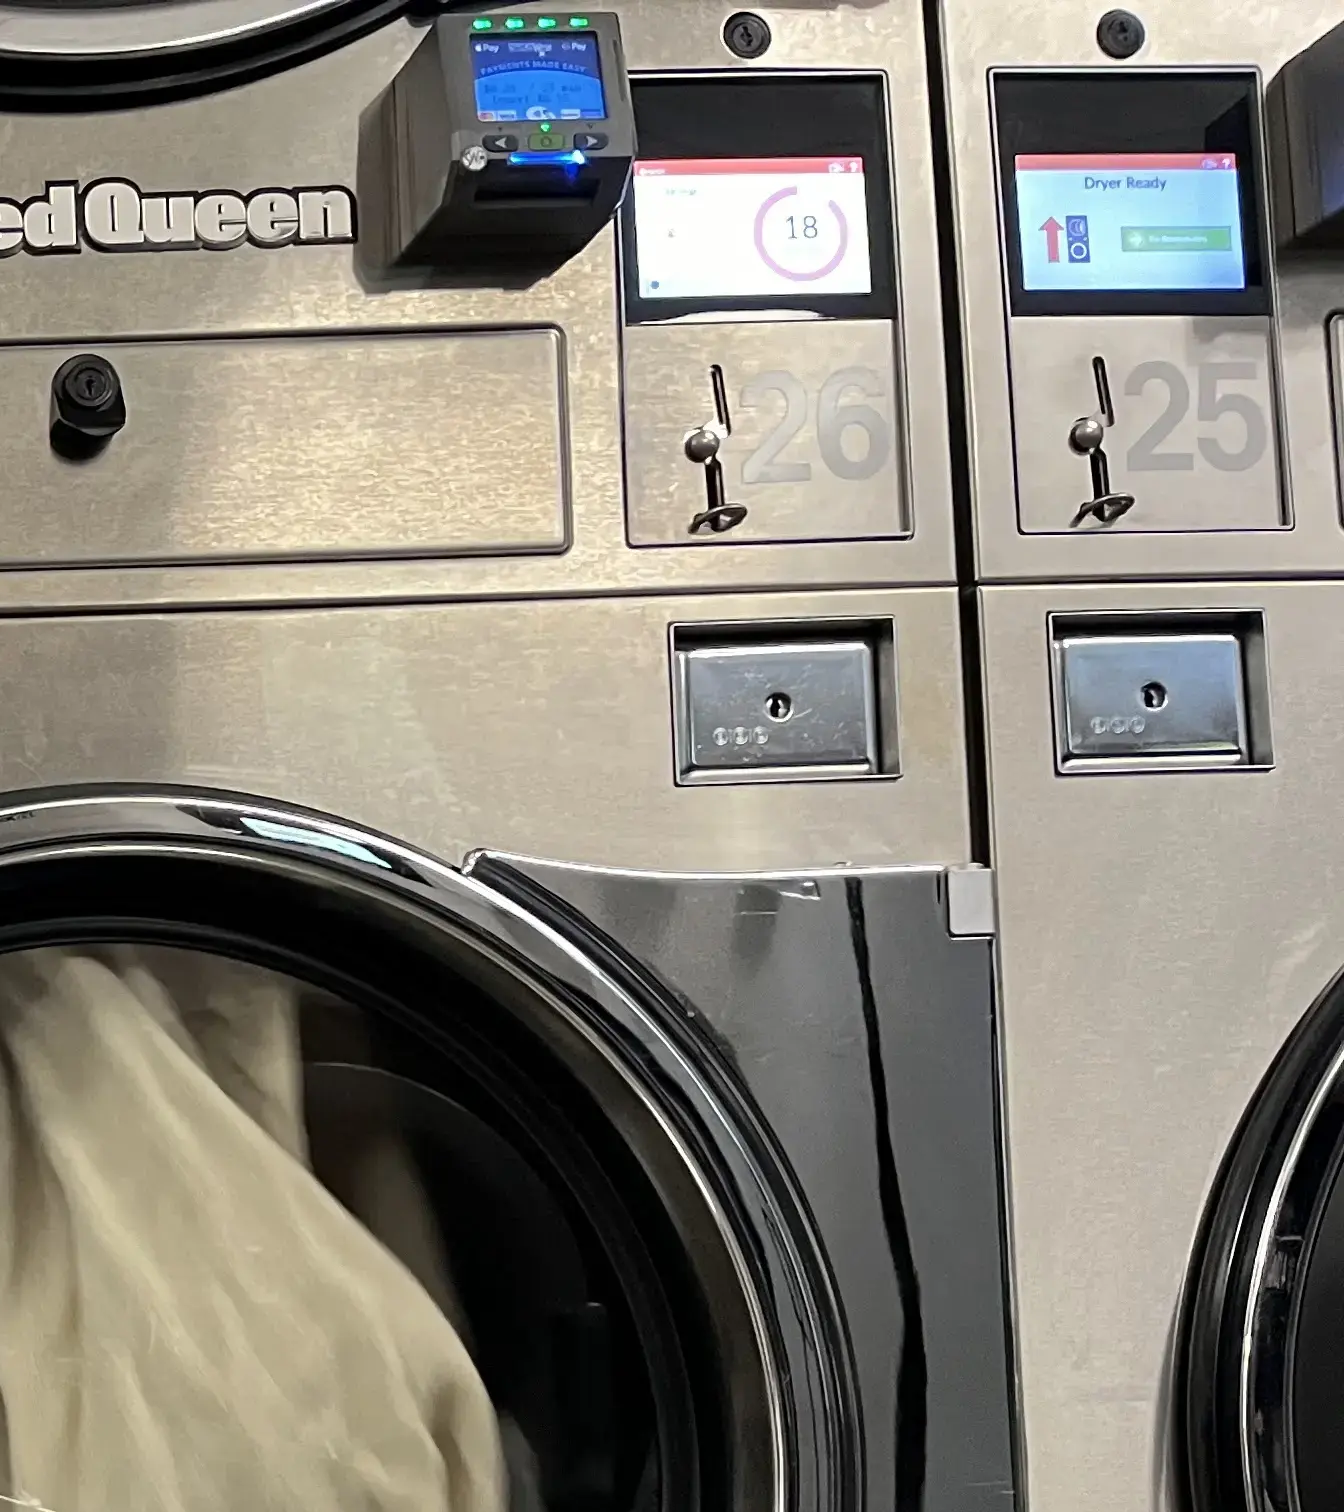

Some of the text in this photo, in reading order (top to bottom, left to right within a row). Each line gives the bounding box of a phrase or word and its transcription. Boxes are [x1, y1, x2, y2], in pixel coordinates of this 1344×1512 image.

[1084, 175, 1167, 191] Dryer Ready
[786, 215, 818, 239] 18
[740, 366, 892, 484] 26
[1124, 360, 1267, 472] 25
